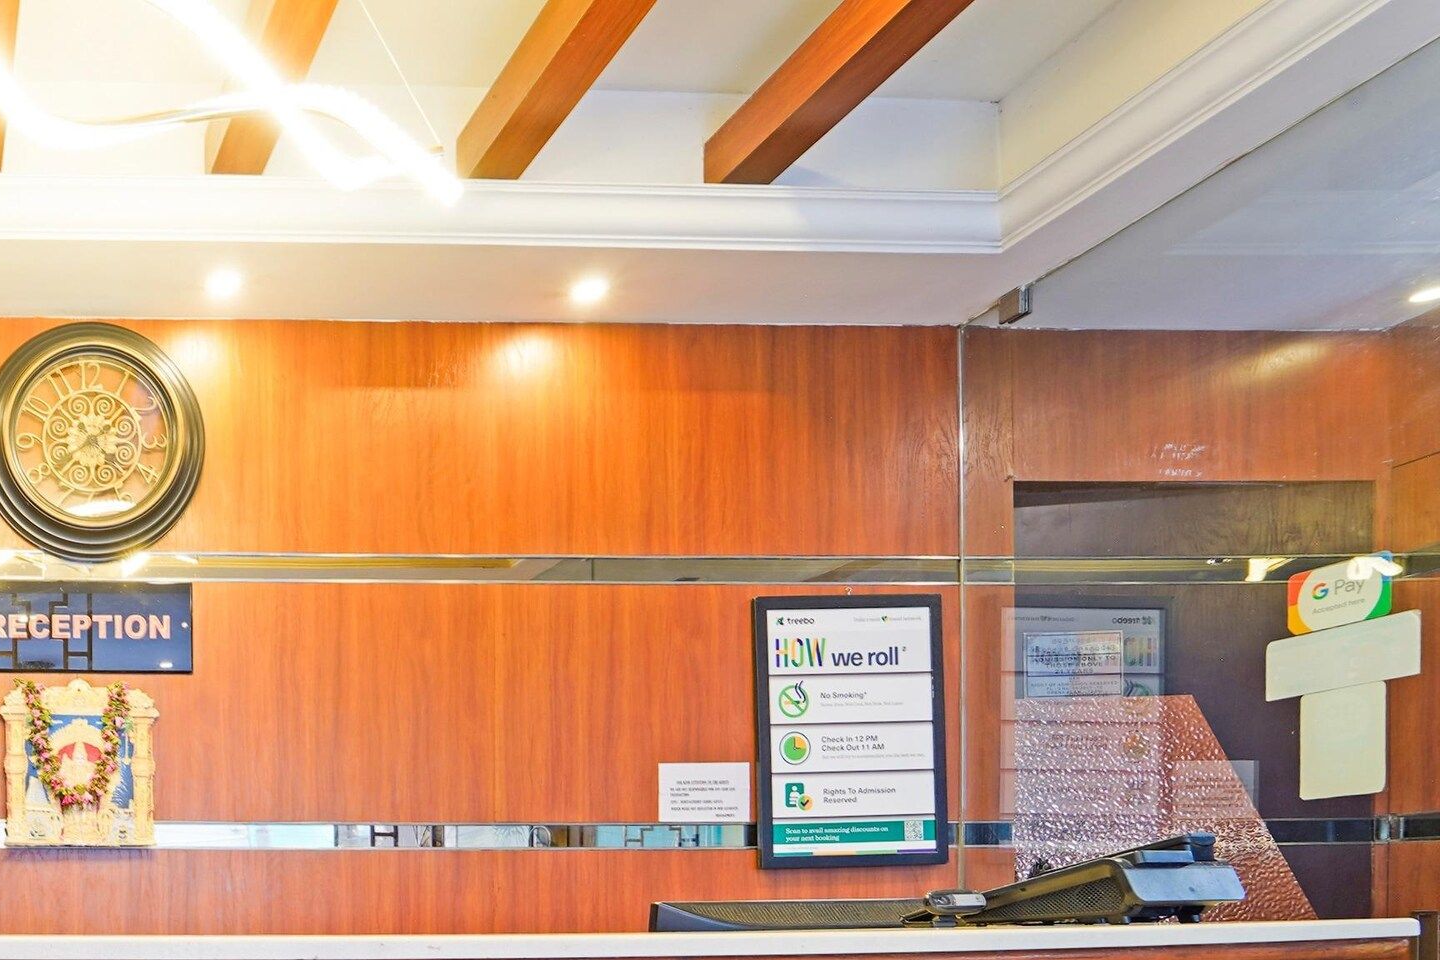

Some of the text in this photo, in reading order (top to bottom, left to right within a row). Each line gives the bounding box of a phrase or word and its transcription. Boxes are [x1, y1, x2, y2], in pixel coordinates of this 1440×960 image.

[1335, 580, 1365, 596] Pay
[1312, 598, 1366, 615] Accepted here
[787, 616, 815, 625] treebo
[775, 638, 826, 668] HOW
[832, 652, 863, 667] we
[868, 646, 898, 666] roll
[821, 744, 845, 752] Check
[822, 788, 846, 796] Rights
[858, 786, 896, 794] Admission
[823, 796, 858, 804] Reserved
[816, 834, 840, 842] booking
